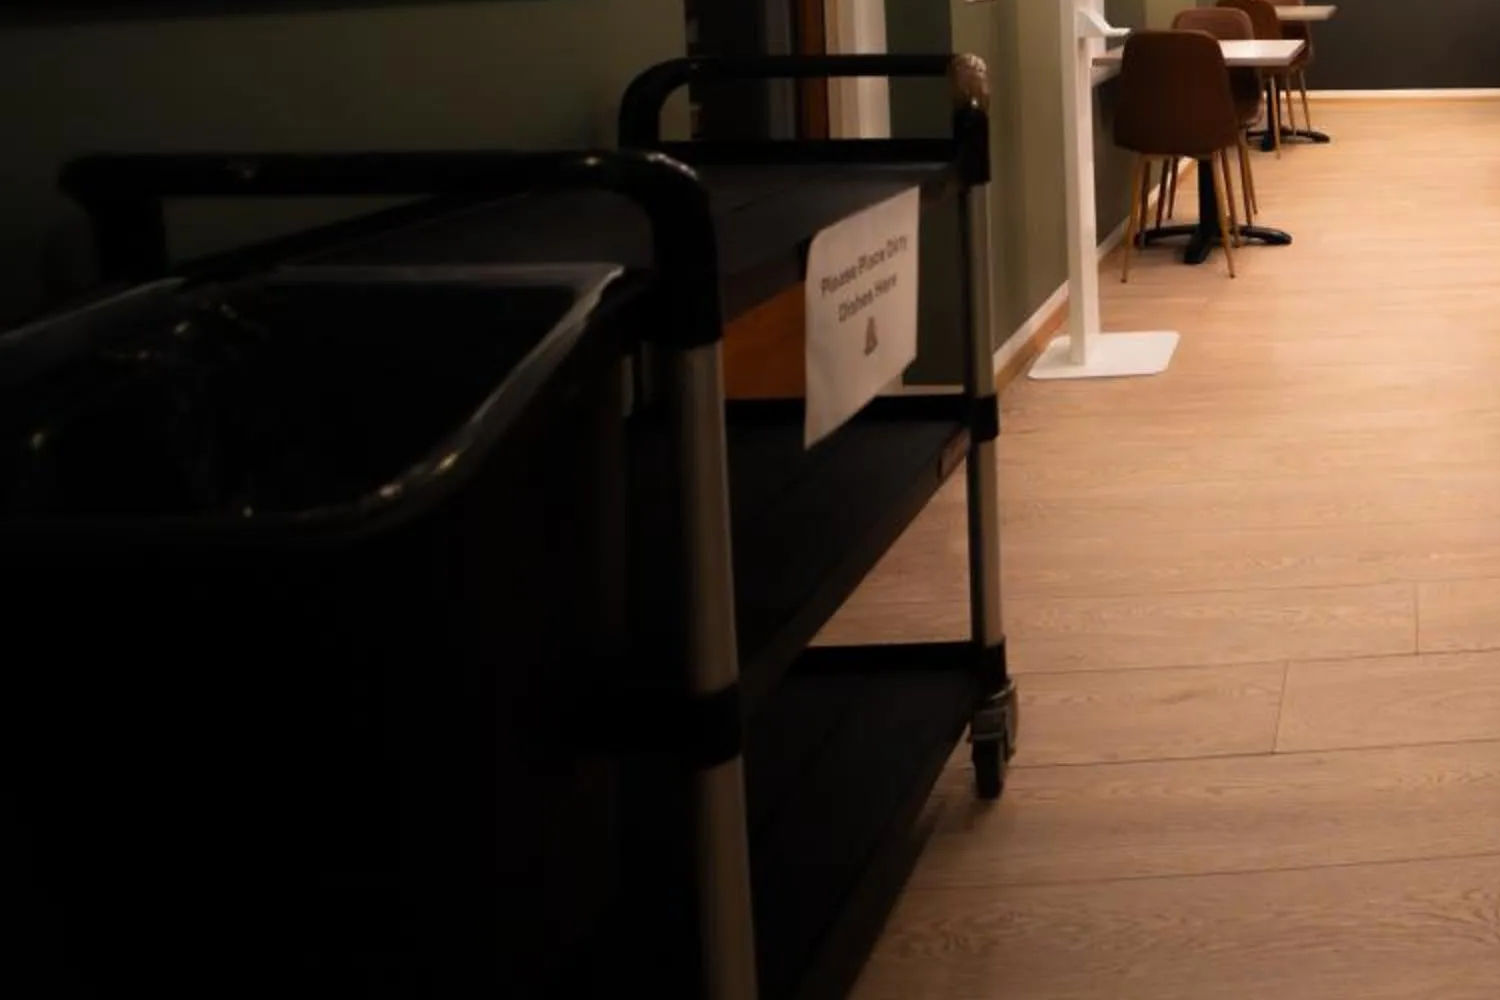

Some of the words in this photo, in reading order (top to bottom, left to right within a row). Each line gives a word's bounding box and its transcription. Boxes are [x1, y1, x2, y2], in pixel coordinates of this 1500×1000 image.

[821, 264, 857, 297] Please
[858, 249, 885, 275] Place
[838, 287, 874, 323] Dishes
[874, 272, 898, 298] Here
